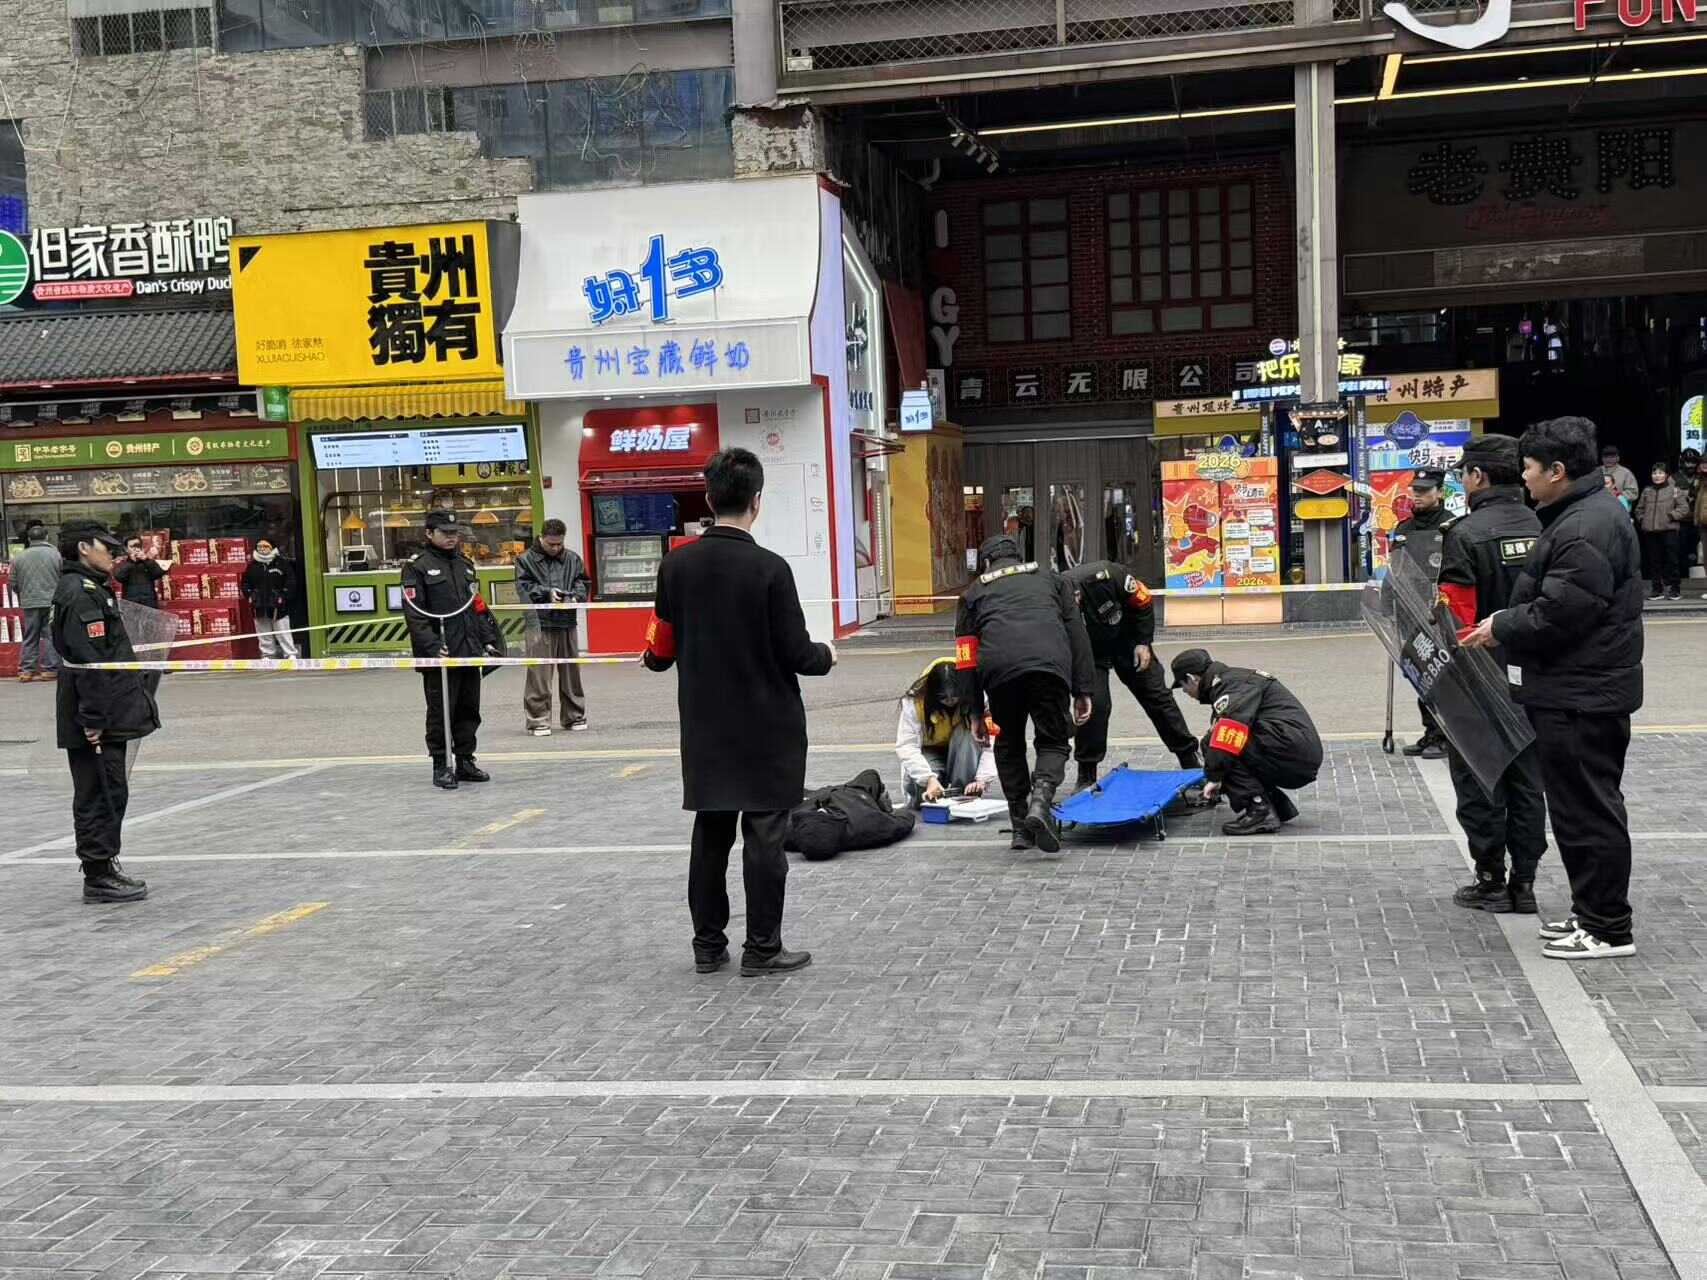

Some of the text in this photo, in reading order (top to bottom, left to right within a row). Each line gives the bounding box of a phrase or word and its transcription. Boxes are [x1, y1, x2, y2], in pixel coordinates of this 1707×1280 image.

[30, 216, 233, 281] 但家香酥鸭
[136, 279, 169, 295] Dan's
[170, 278, 205, 295] Crispy
[364, 235, 478, 304] 貴州
[367, 299, 481, 366] 獨有
[563, 337, 751, 381] 贵州宝藏鲜奶
[958, 361, 1258, 400] 青云无限公司
[608, 425, 691, 453] 鲜奶屋
[1198, 454, 1241, 468] 2026
[1236, 577, 1264, 587] 2026
